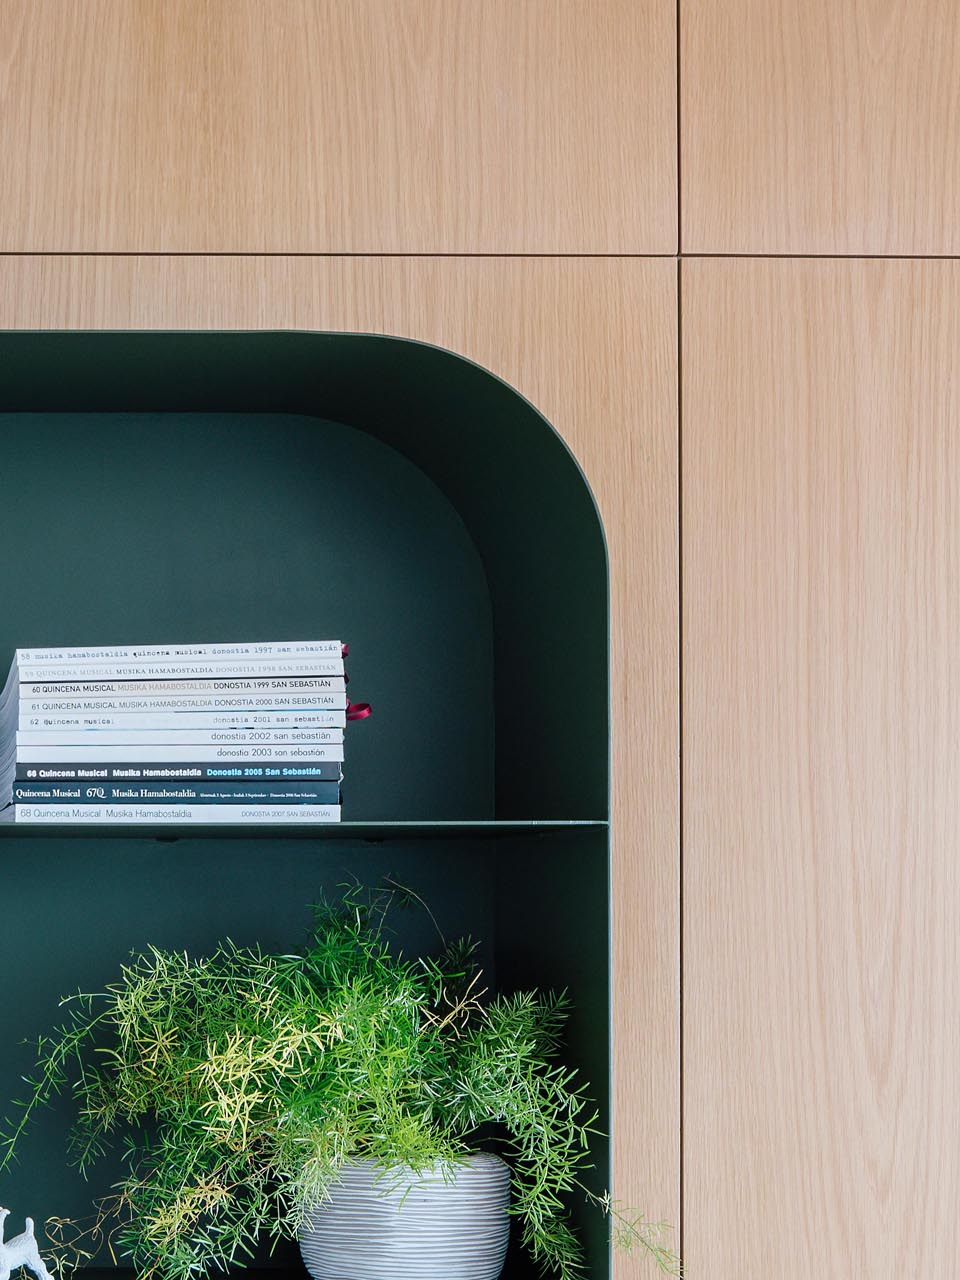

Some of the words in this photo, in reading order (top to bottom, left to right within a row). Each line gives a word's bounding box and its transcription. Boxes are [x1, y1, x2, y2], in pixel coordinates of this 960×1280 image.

[291, 732, 331, 740] sebastián
[217, 749, 249, 757] donostia
[251, 749, 272, 757] 2003
[290, 748, 325, 756] sebastián
[143, 768, 202, 777] Hamabostaldia
[282, 767, 321, 775] Sebastián
[16, 789, 51, 798] Quincena
[52, 788, 80, 797] Musical
[112, 789, 138, 797] Musika
[140, 788, 196, 797] Hamabostaldia
[34, 809, 70, 818] Quincena
[72, 809, 101, 817] Musical
[106, 809, 133, 818] Musika
[135, 808, 192, 818] Hamabostaldia
